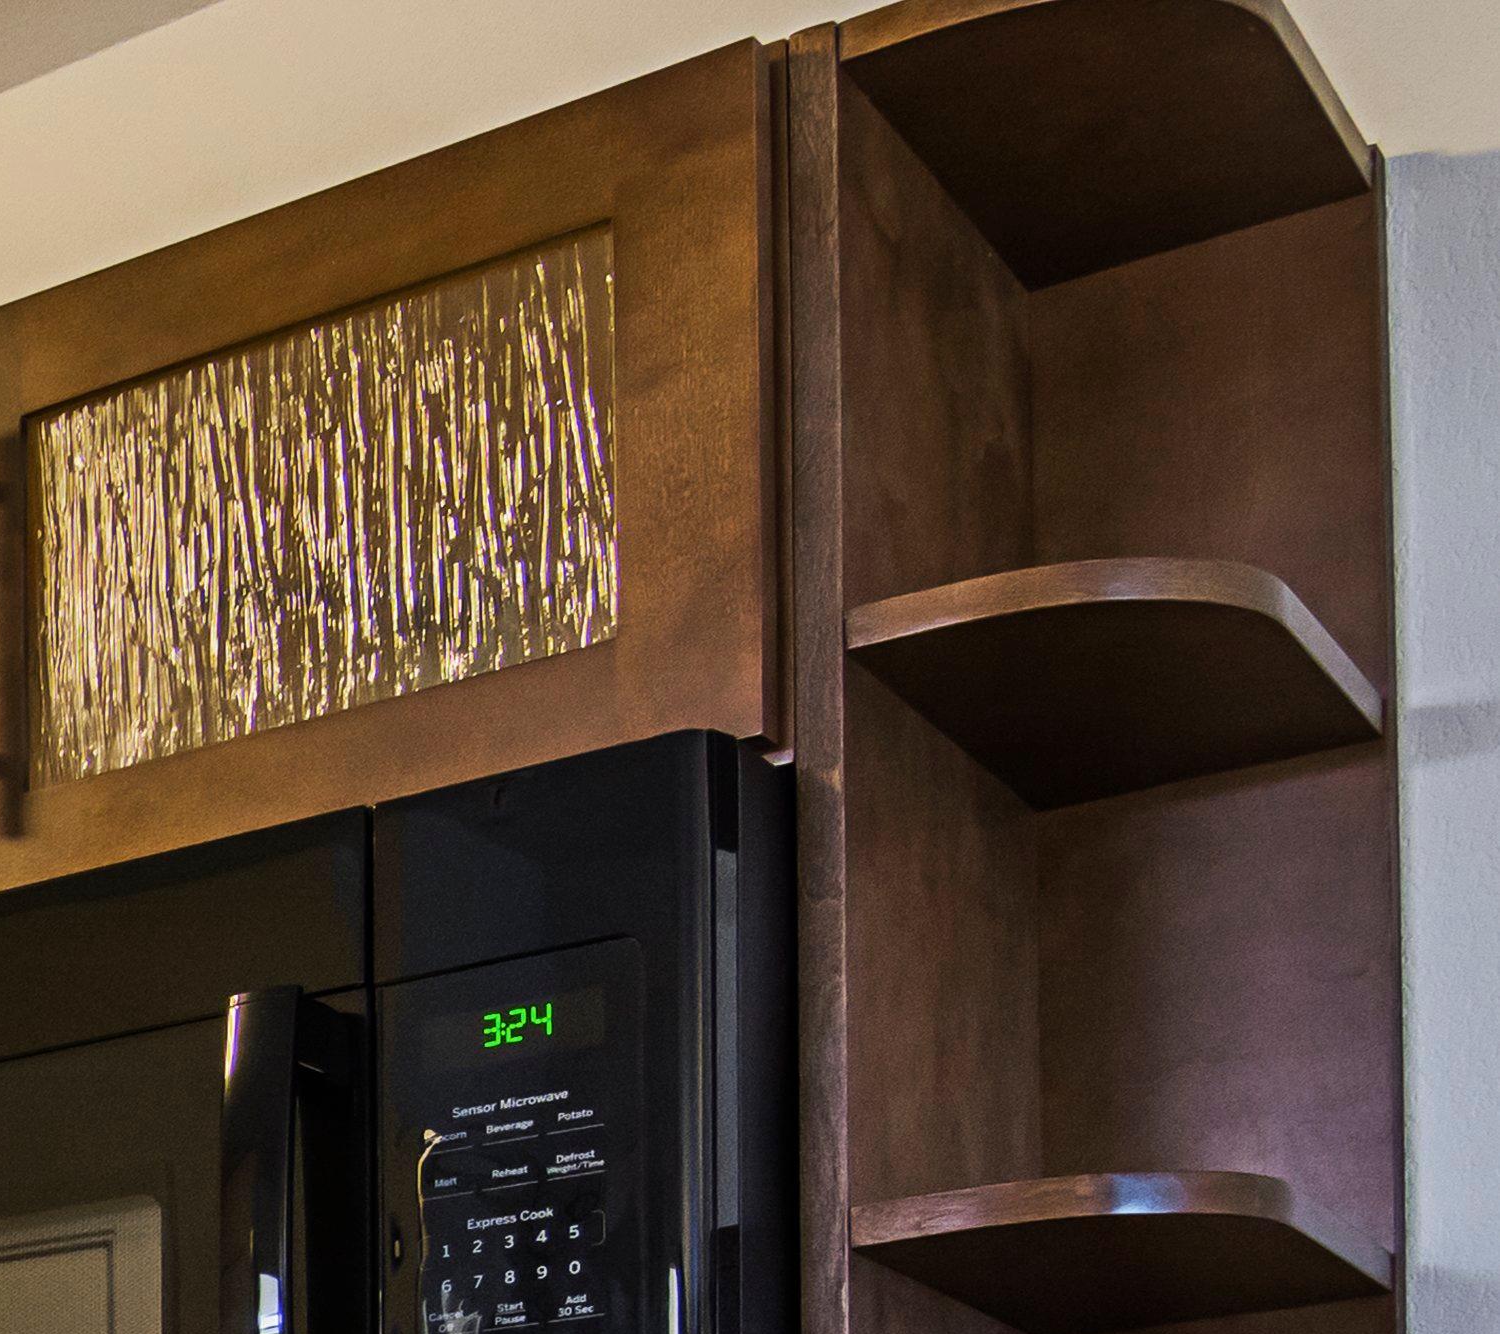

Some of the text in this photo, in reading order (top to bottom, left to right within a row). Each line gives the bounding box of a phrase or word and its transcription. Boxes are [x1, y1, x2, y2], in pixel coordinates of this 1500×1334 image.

[483, 1002, 552, 1048] 3:24
[452, 1090, 569, 1118] Sensor Microwave
[486, 1120, 534, 1134] Beverage
[557, 1109, 594, 1121] Potato
[492, 1165, 528, 1179] Reheat
[556, 1149, 595, 1164] Defrost
[467, 1207, 554, 1231] Express Cook
[442, 1224, 579, 1258] 1 2 3 4 5
[441, 1260, 581, 1293] 6 7 8 9 0
[495, 1313, 526, 1326] Pause
[558, 1307, 572, 1317] 30
[574, 1304, 595, 1314] Sec
[497, 1301, 524, 1313] Start
[565, 1294, 587, 1305] Add
